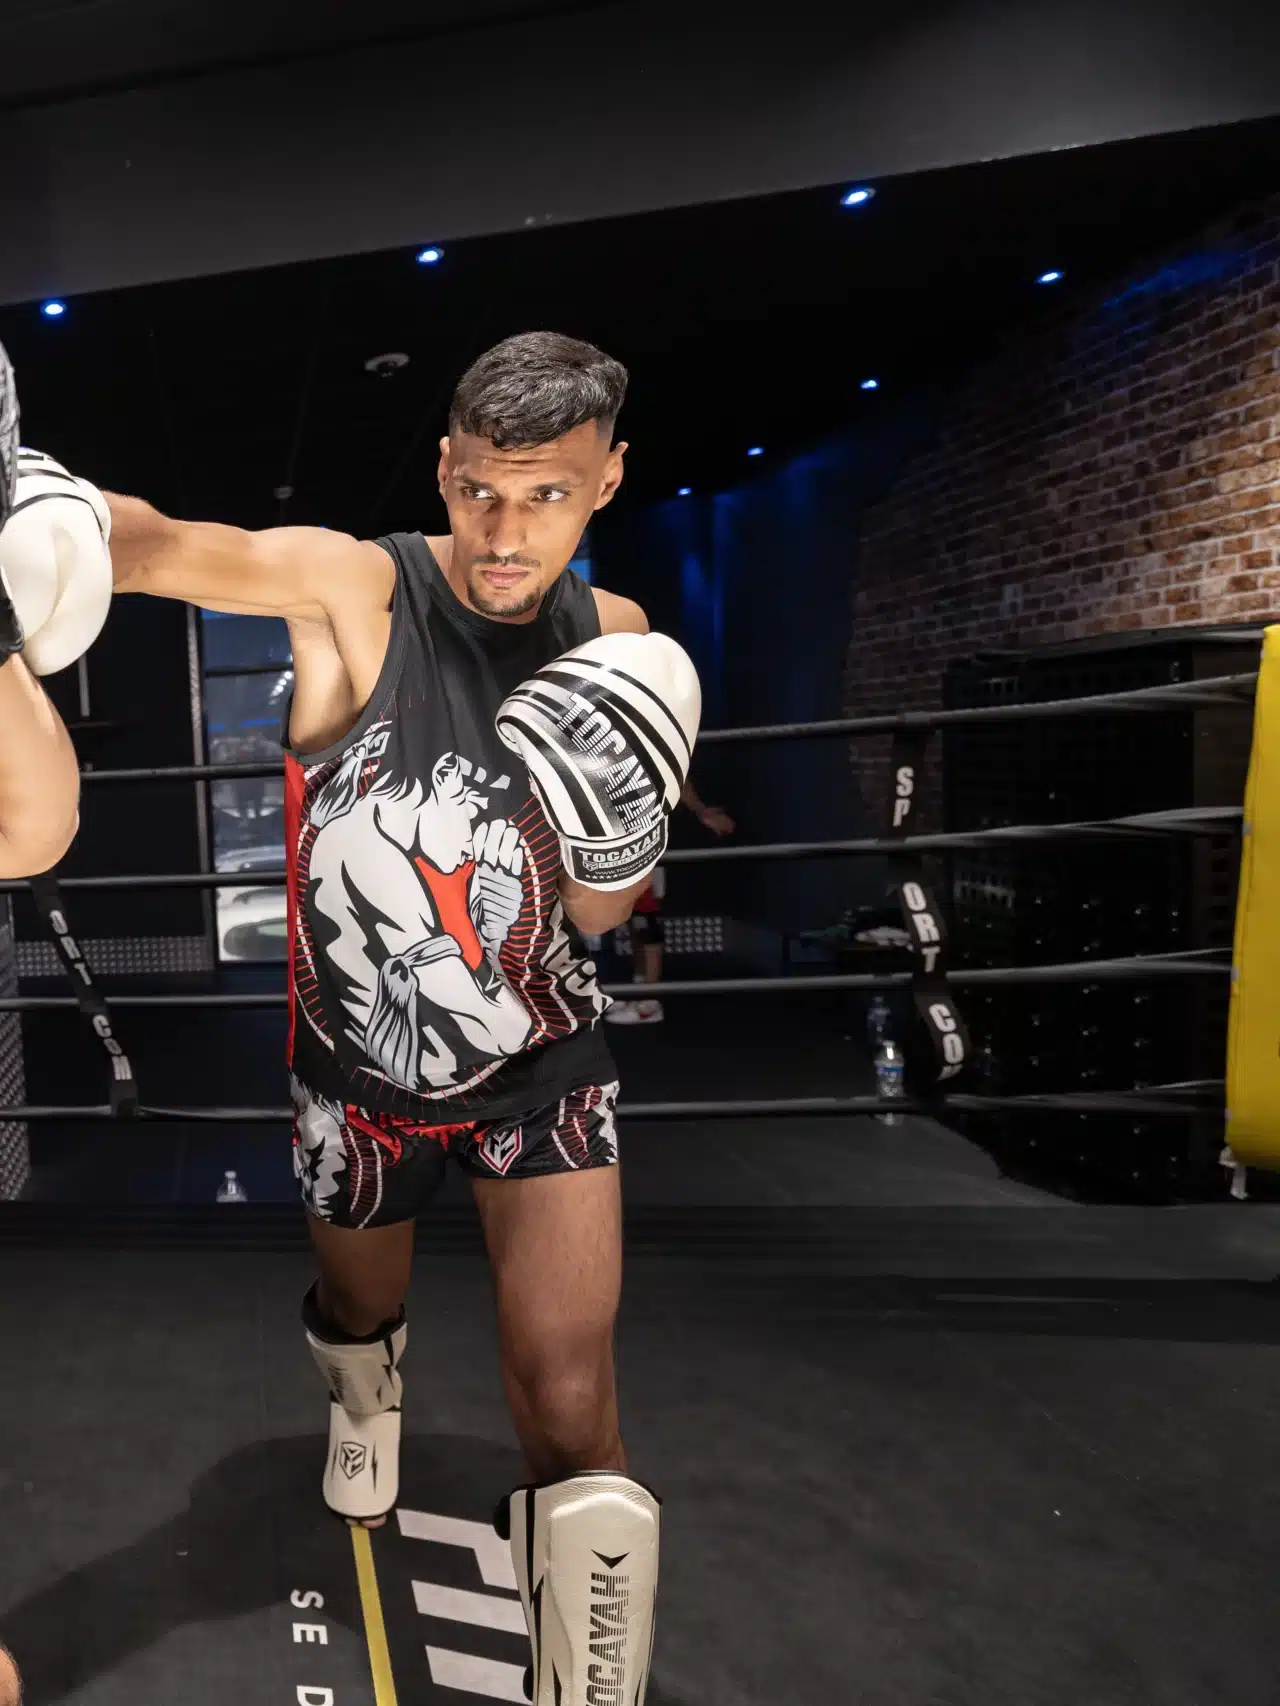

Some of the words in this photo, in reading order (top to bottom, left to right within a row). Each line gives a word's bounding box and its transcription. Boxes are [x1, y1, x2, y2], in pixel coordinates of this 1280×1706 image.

[557, 692, 664, 834] TOCAYAH
[578, 823, 661, 862] TOCAYAH
[585, 1572, 629, 1706] OCAYAH
